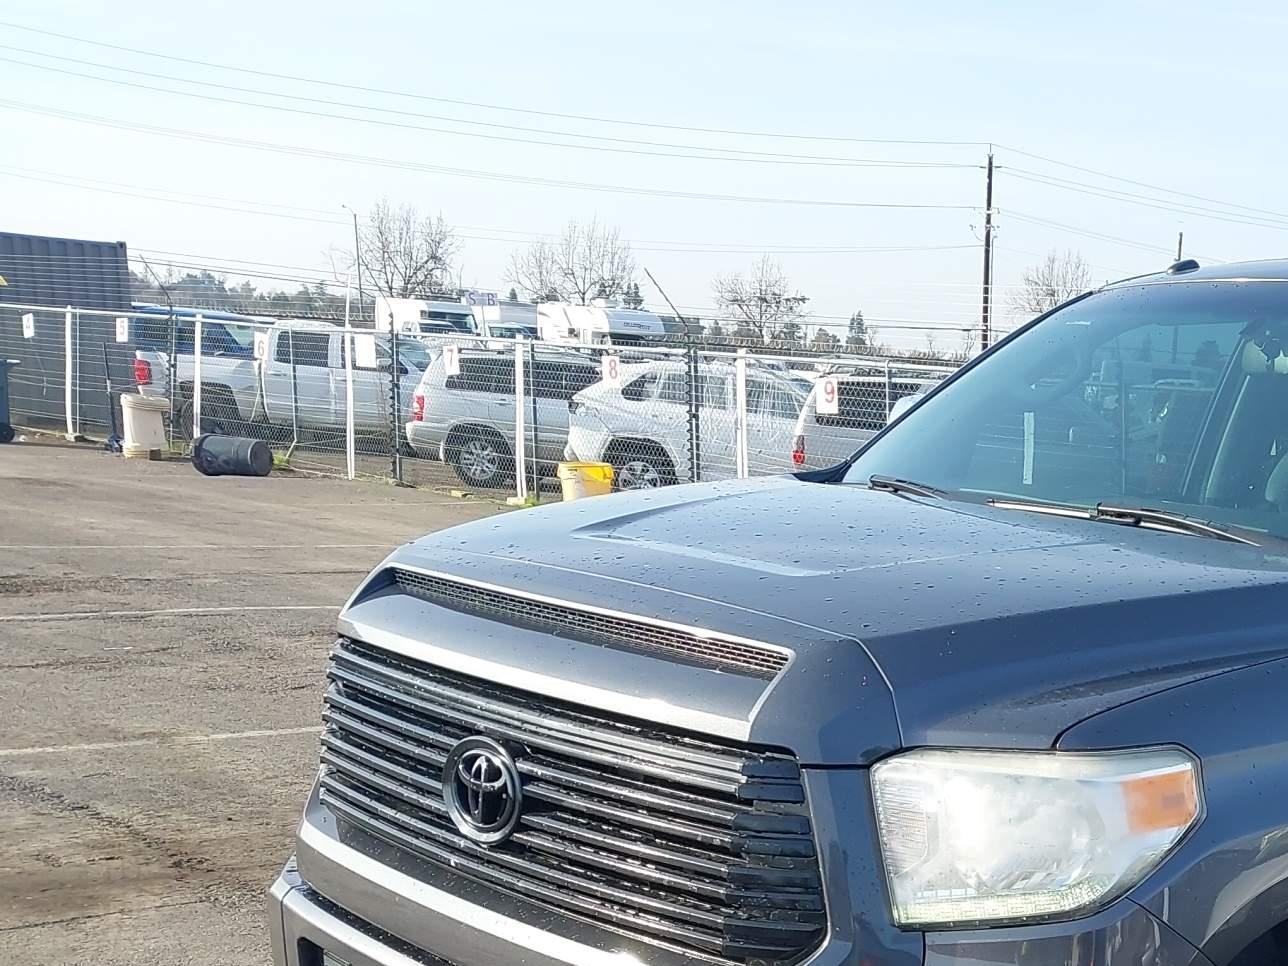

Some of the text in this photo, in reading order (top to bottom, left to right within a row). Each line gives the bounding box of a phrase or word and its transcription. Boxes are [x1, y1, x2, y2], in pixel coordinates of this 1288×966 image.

[257, 340, 265, 357] 6
[446, 347, 455, 368] 7
[609, 359, 618, 380] 8
[823, 379, 836, 404] 9
